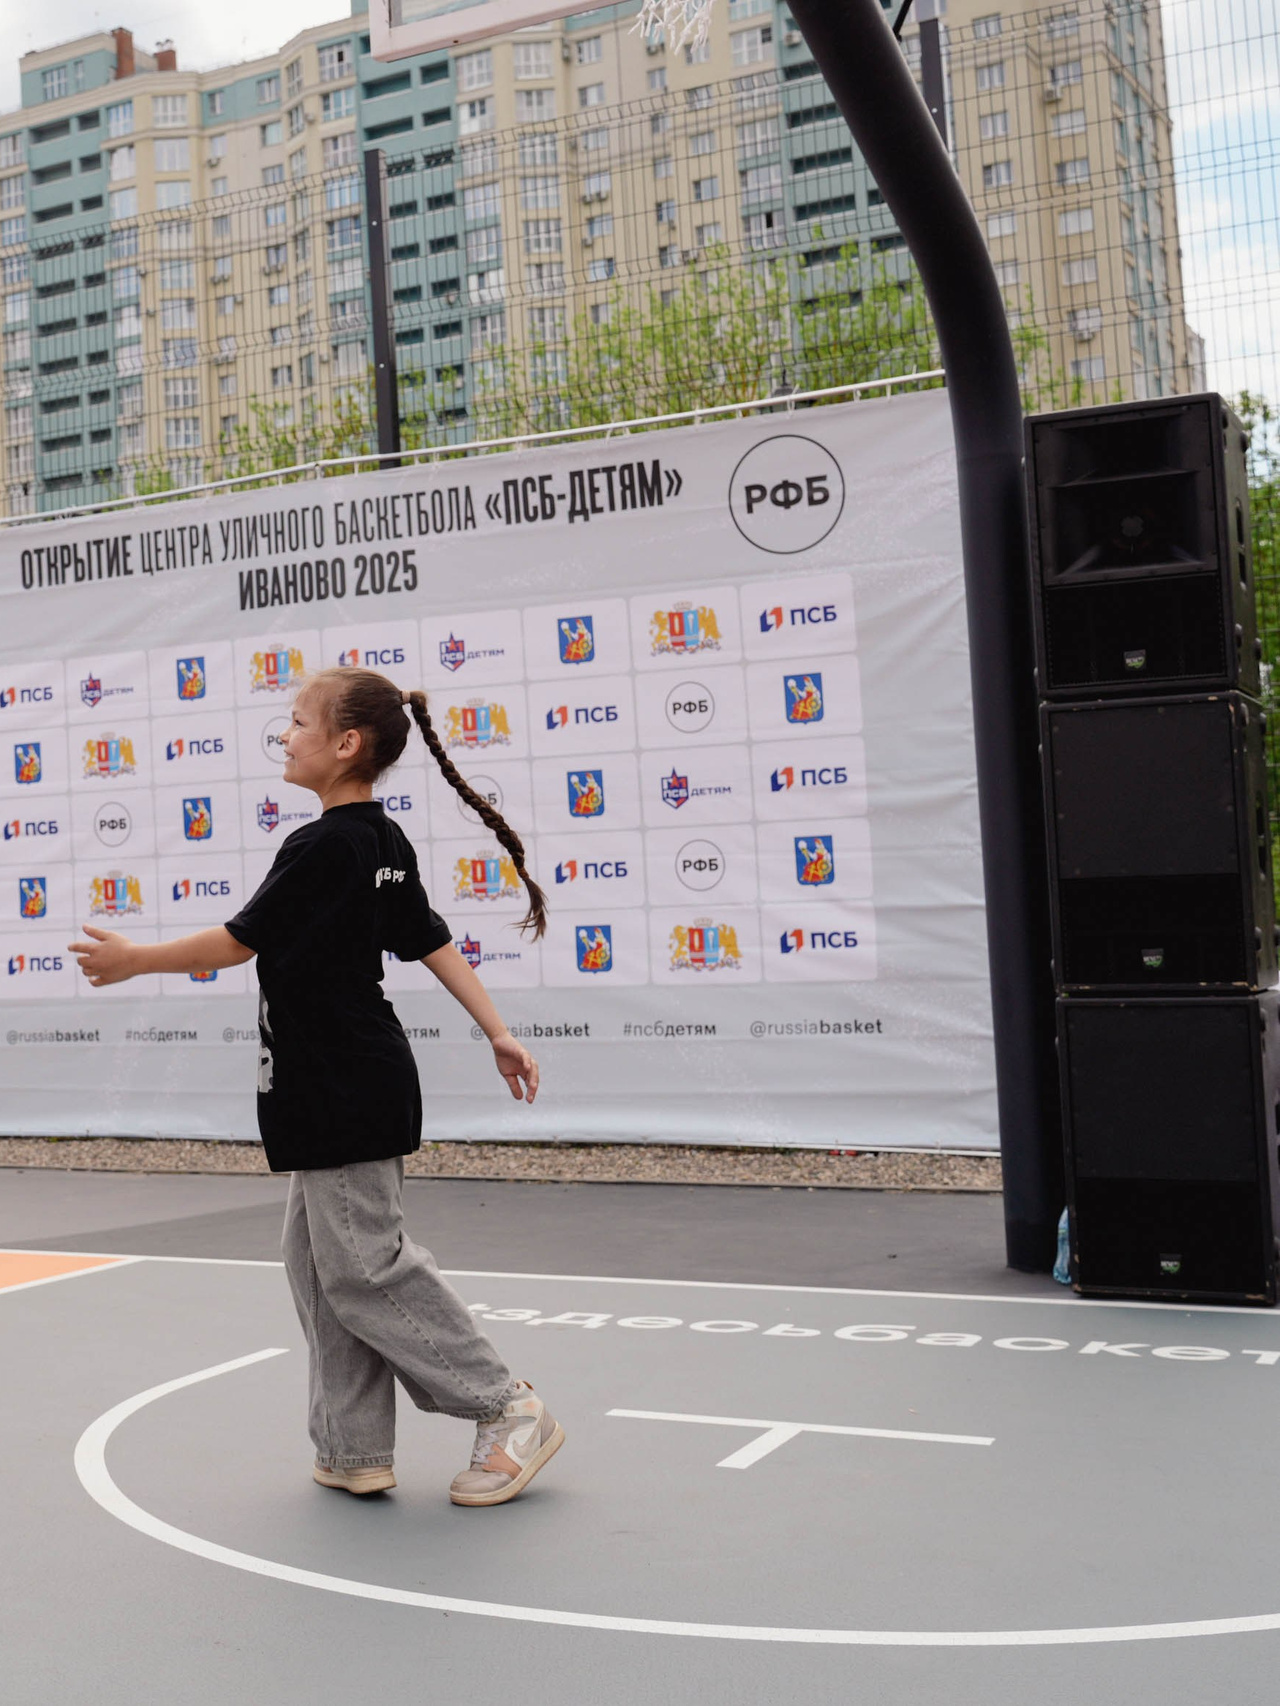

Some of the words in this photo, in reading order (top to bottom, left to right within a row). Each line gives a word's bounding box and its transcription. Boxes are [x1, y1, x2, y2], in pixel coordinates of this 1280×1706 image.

[744, 474, 830, 514] РФБ
[21, 534, 133, 590] ОТКРЫТИЕ
[140, 523, 213, 574] ЦЕНТРА
[219, 505, 324, 562] УЛИЧНОГО
[335, 485, 477, 545] БАСКЕТБОЛА
[485, 459, 683, 525] «ПСБ-ДЕТЯМ»
[238, 557, 346, 611] ИВАНОВО
[354, 549, 418, 597] 2025
[790, 605, 837, 626] ПСБ
[365, 648, 405, 666] ПСБ
[467, 648, 505, 660] ДЕТЯМ
[20, 687, 53, 703] ПСБ
[575, 706, 618, 725] ПСБ
[672, 700, 709, 715] РФБ
[189, 738, 224, 755] ПСБ
[802, 768, 848, 786] ПСБ
[691, 785, 732, 797] ДЕТЯМ
[25, 820, 58, 836] ПСБ
[99, 817, 127, 831] РФБ
[584, 861, 628, 879] ПСБ
[682, 858, 719, 872] РФБ
[195, 880, 231, 897] ПСБ
[811, 931, 858, 949] ПСБ
[30, 956, 63, 972] ПСБ
[483, 952, 521, 961] ДЕТЯМ
[6, 1028, 100, 1044] @russiabasket
[125, 1027, 198, 1042] #псбдетям
[470, 1022, 591, 1041] @siabasket
[623, 1020, 717, 1037] #псбдетям
[750, 1018, 883, 1037] @russiabasket
[467, 1303, 1280, 1366] здесьбаскет
